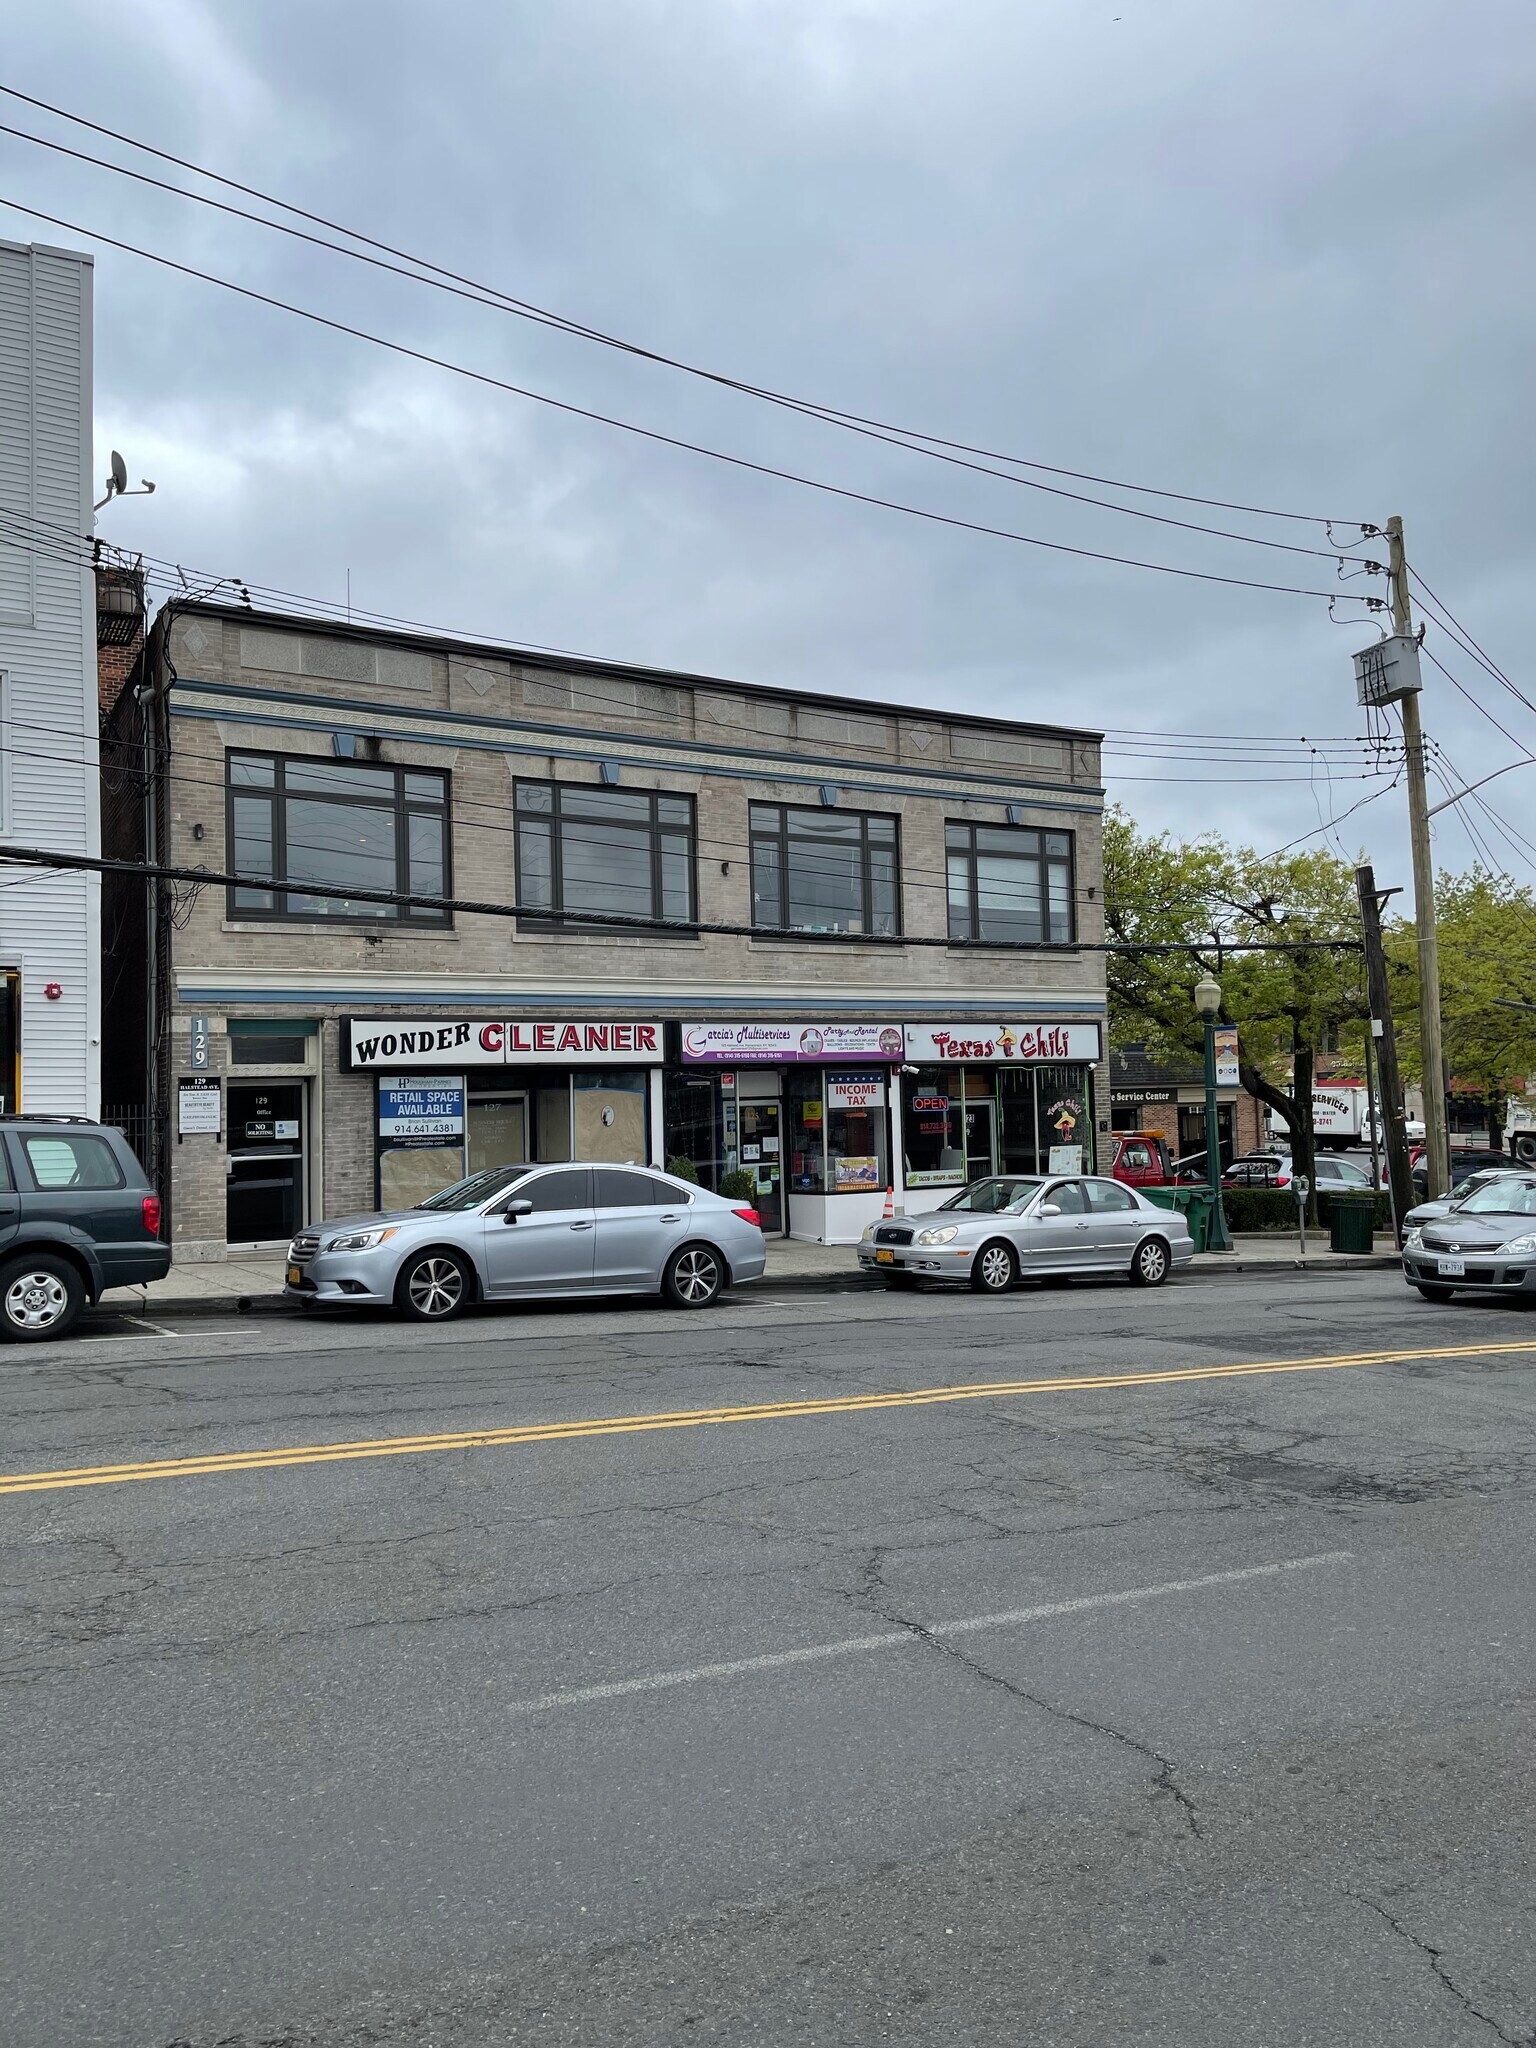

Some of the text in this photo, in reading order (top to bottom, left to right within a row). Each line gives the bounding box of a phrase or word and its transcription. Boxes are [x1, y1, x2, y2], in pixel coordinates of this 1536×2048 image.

[736, 1025, 791, 1043] Multiservices
[823, 1026, 843, 1037] Party
[854, 1026, 878, 1036] Rental
[195, 1019, 206, 1065] 129
[355, 1022, 658, 1063] WONDER CLEANER
[931, 1026, 1069, 1058] Texas Chili
[835, 1085, 877, 1095] INCOME
[390, 1092, 460, 1103] RETAIL SPACE
[847, 1096, 867, 1105] TAX
[1116, 1092, 1144, 1100] Service
[1145, 1092, 1169, 1100] Center
[914, 1098, 947, 1109] OPEN
[1312, 1094, 1349, 1114] SERVICES
[398, 1104, 452, 1115] AVAILABLE
[394, 1124, 454, 1133] 914.641.4381
